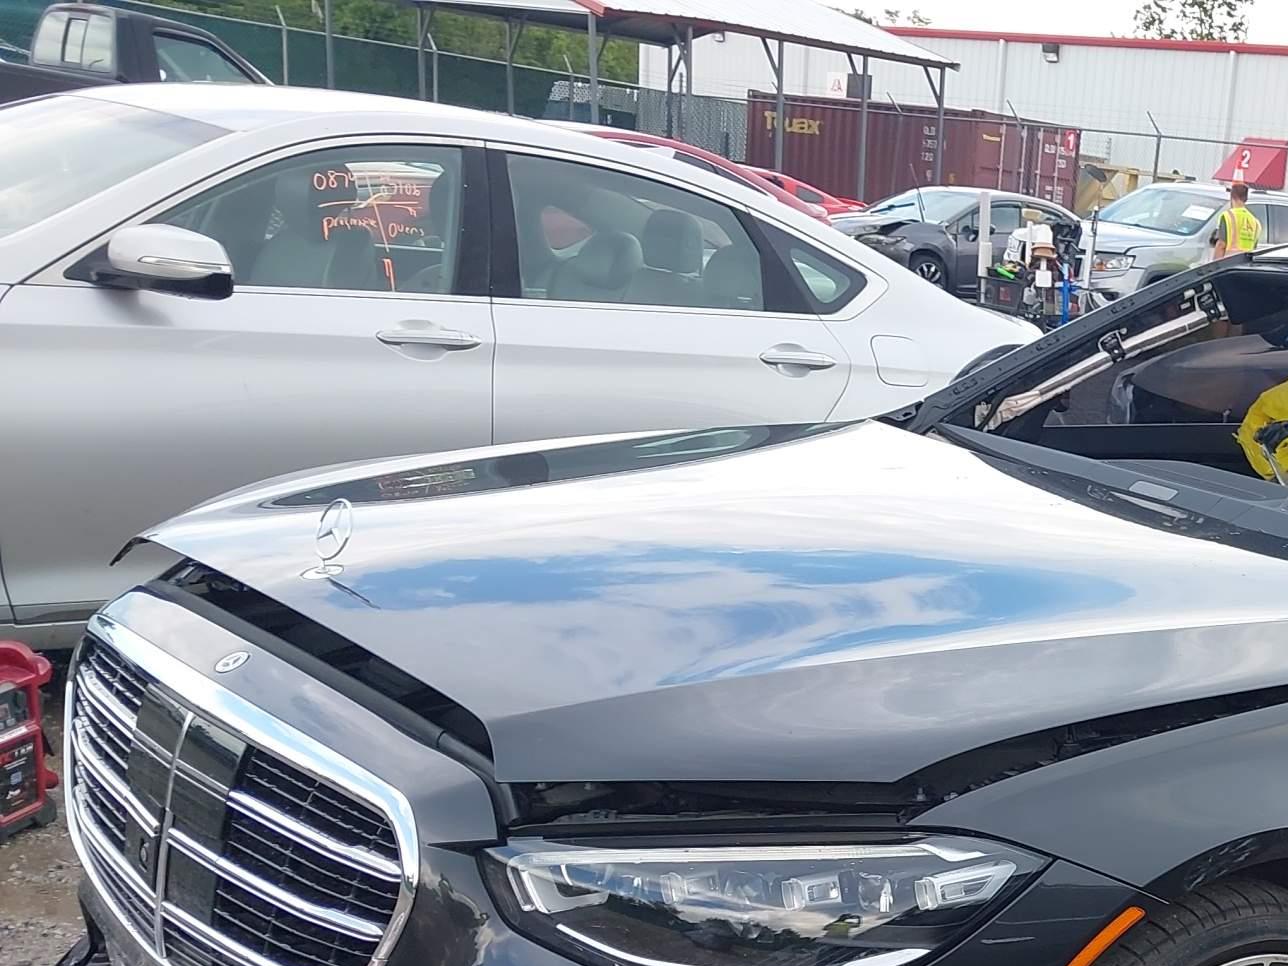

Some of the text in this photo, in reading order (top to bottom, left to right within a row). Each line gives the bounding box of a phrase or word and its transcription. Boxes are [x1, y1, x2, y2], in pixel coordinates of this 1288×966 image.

[764, 111, 820, 135] Tuax
[1067, 133, 1075, 150] 1
[1241, 150, 1251, 168] 2
